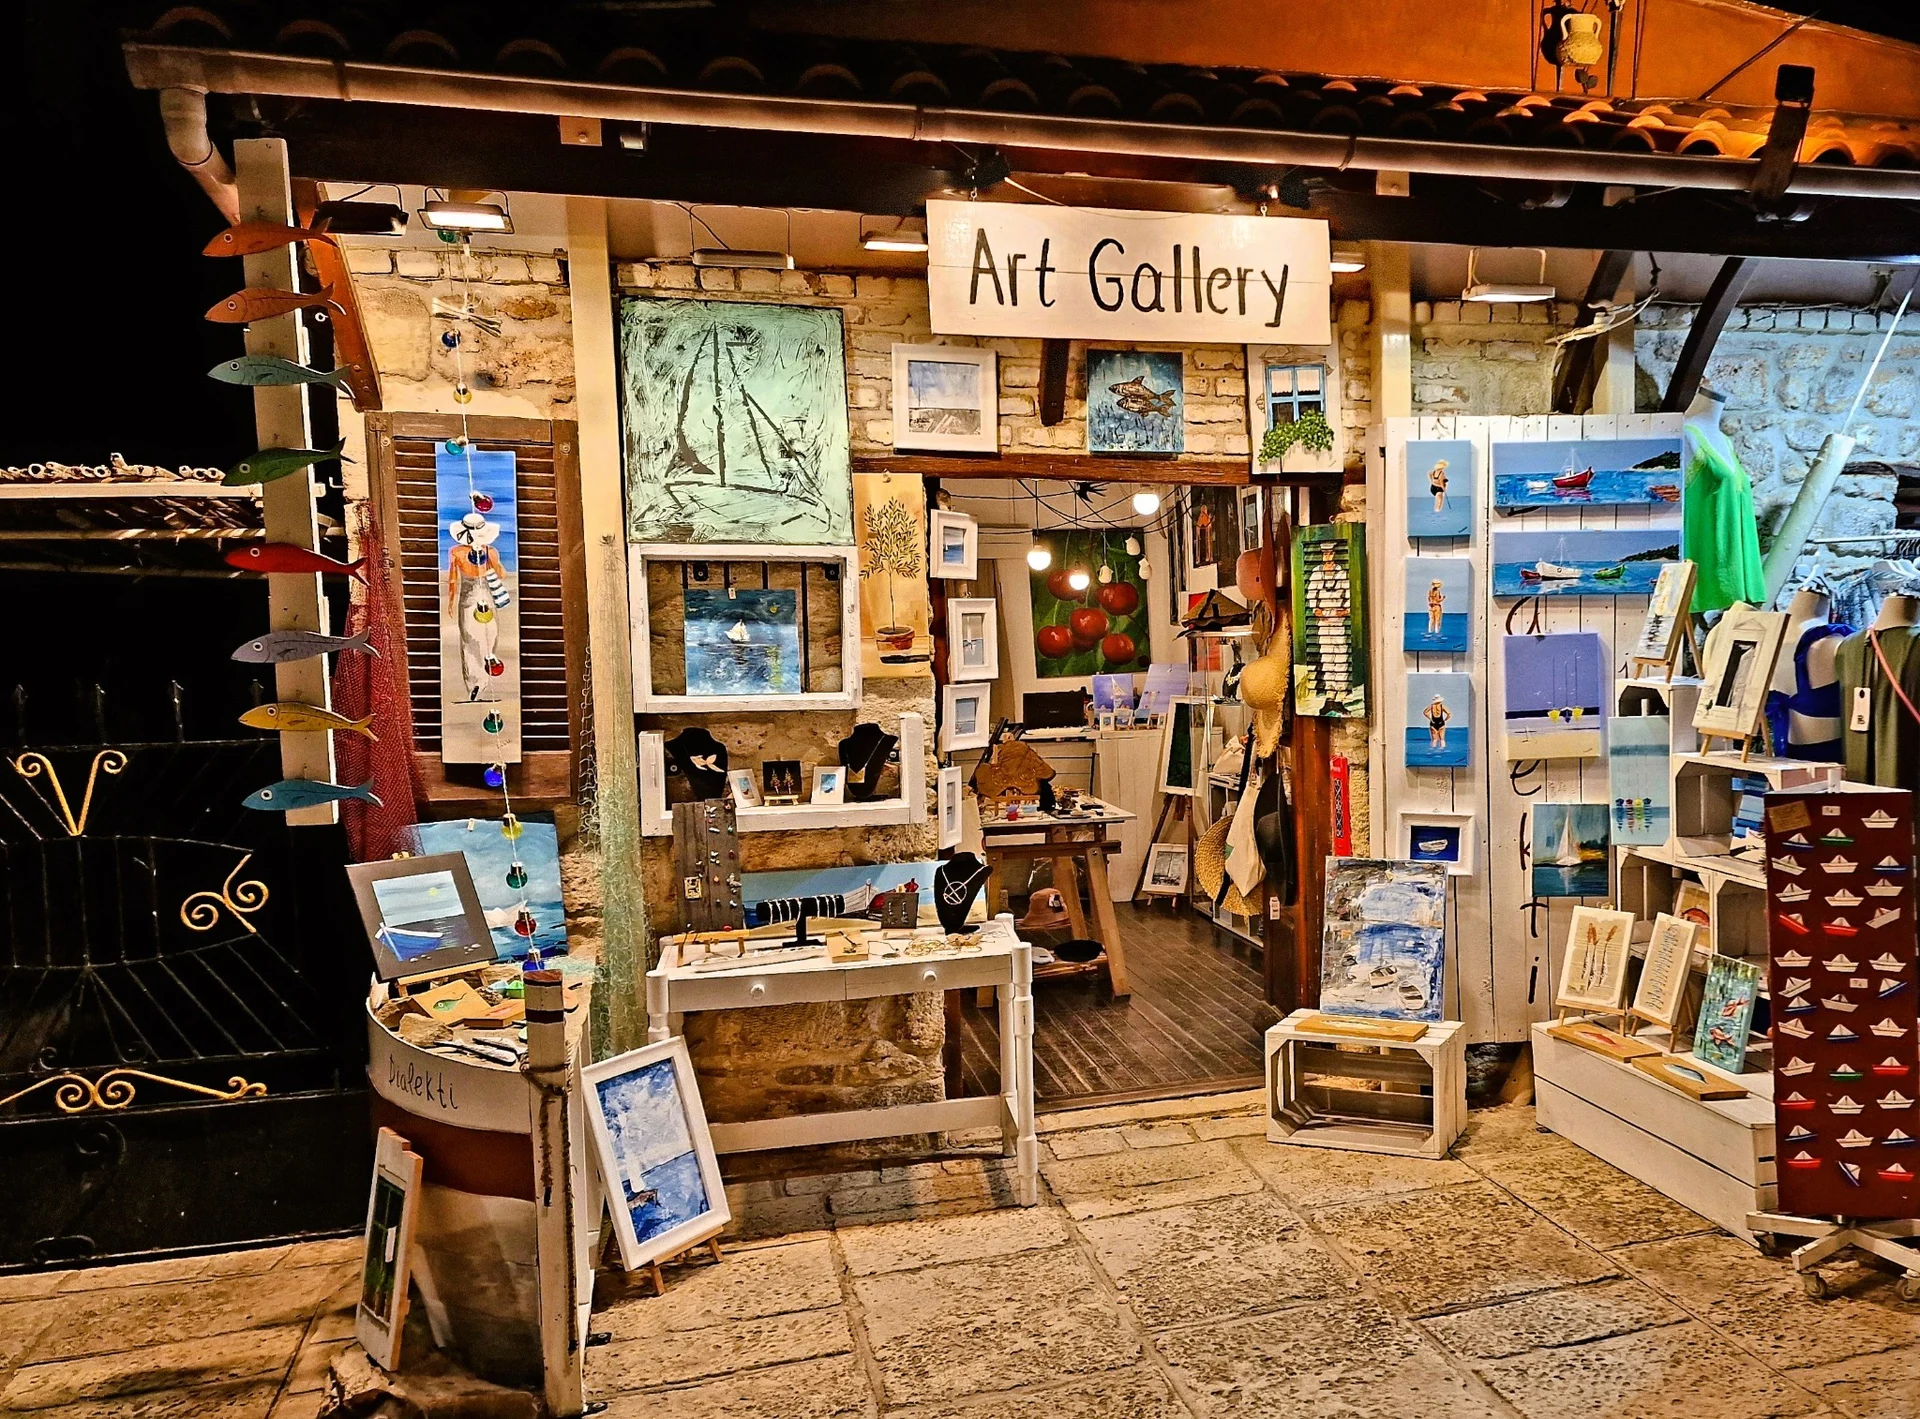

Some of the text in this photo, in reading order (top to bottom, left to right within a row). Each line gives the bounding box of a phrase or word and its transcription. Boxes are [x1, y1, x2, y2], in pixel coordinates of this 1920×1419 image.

[969, 227, 1289, 328] Art Gallery
[388, 1053, 459, 1110] Dialekti
